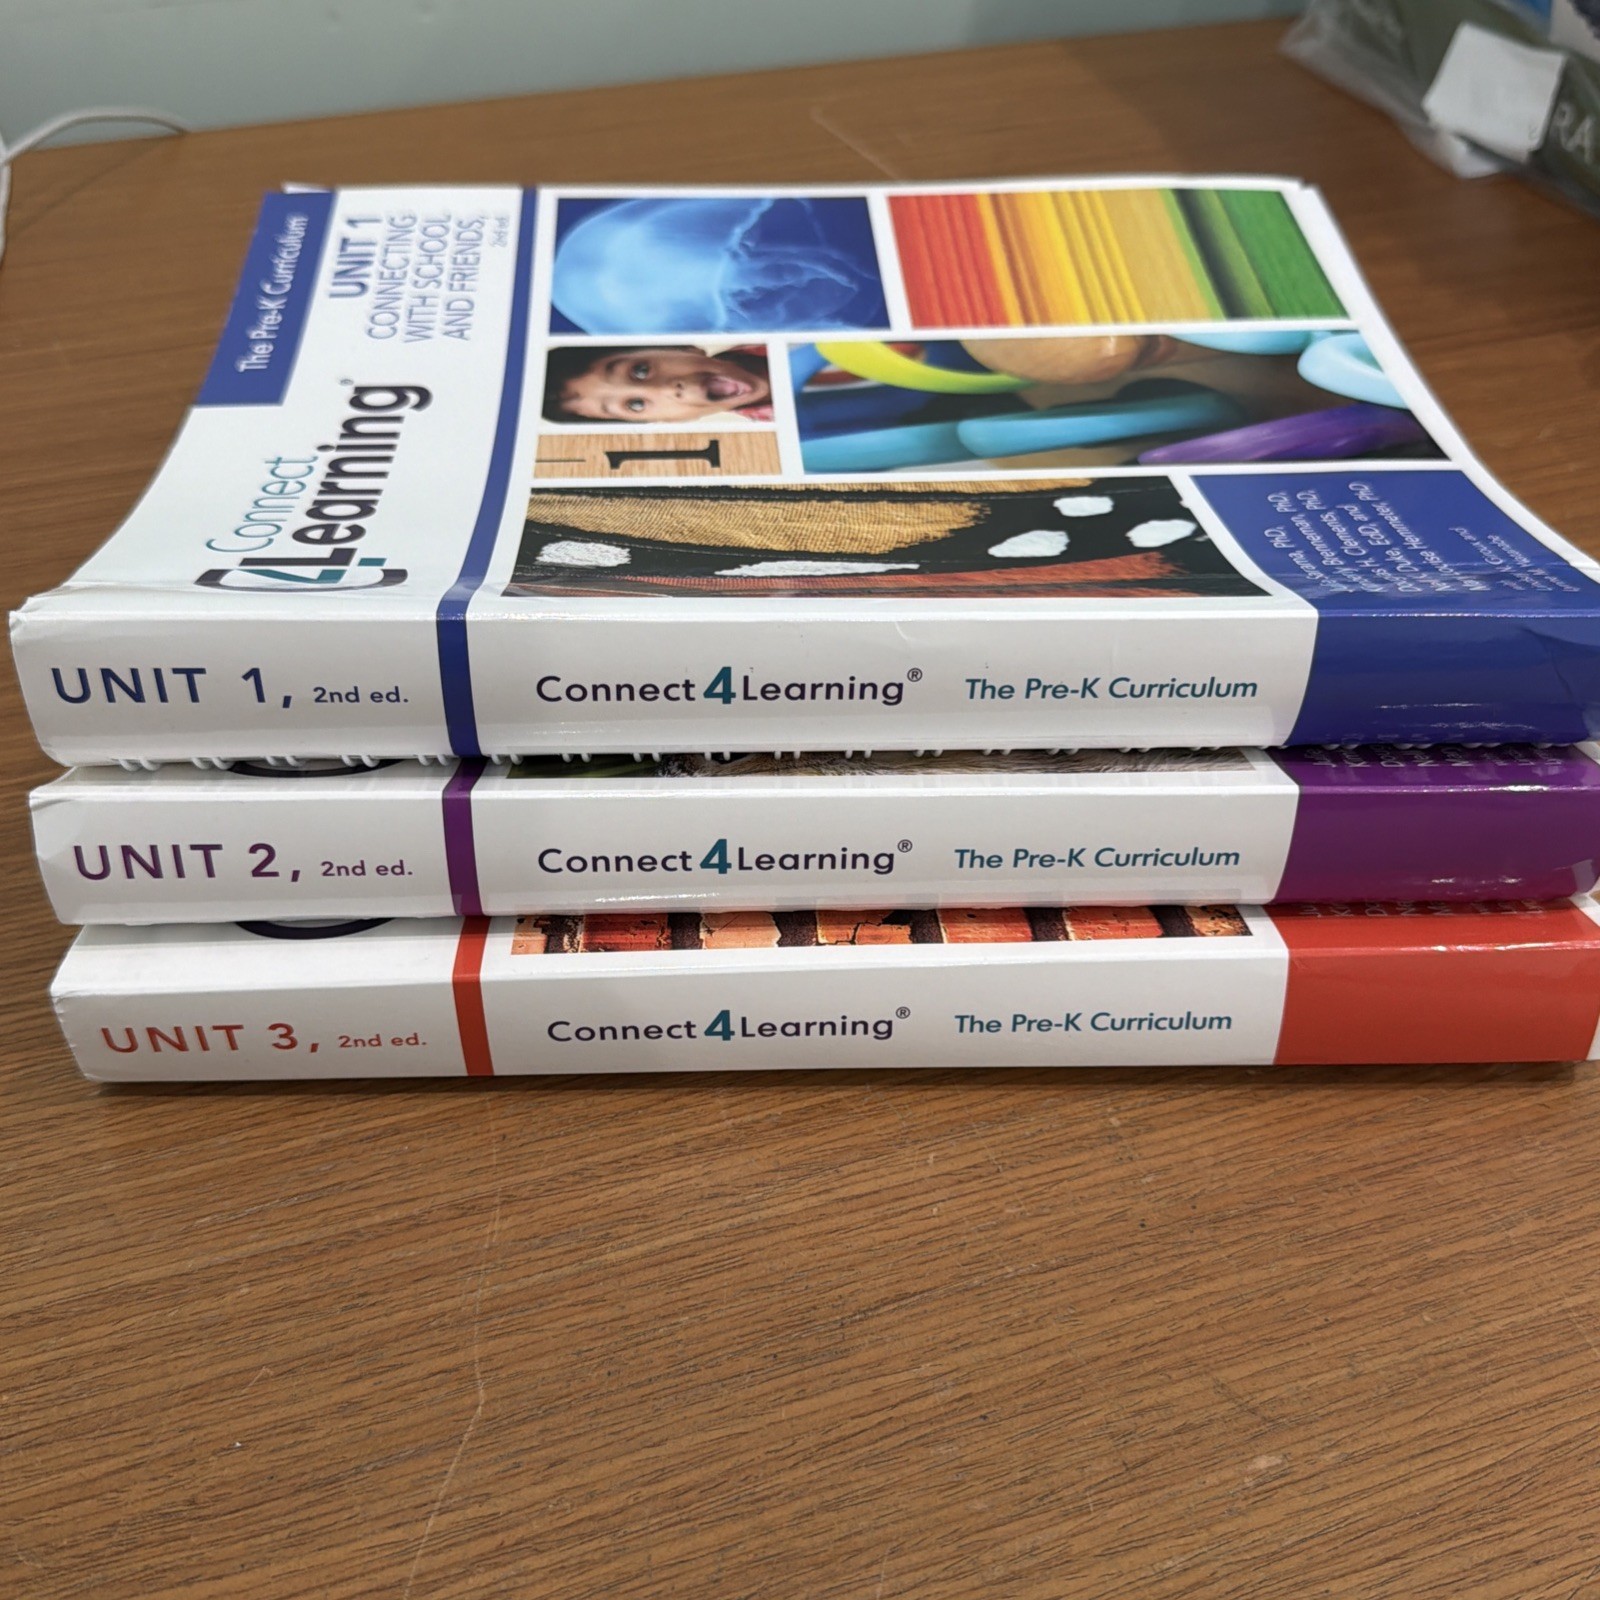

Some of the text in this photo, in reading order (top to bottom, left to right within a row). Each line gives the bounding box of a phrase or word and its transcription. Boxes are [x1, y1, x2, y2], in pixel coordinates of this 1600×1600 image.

[329, 218, 383, 299] UNIT 1
[367, 214, 417, 339] CONNECTING
[403, 214, 451, 343] WITH SCHOOL
[442, 214, 488, 341] AND FRIENDS,
[235, 214, 309, 373] The Pre-K Curriculum
[605, 439, 721, 469] 1
[206, 456, 318, 553] Connect
[1348, 483, 1379, 502] PhD
[1335, 505, 1369, 521] and
[51, 667, 409, 709] UNIT 1, 2nd ed.
[965, 676, 1258, 700] The Pre-K Curriculum
[73, 843, 414, 883] UNIT 2, 2nd ed.
[954, 846, 1241, 869] The Pre-K Curriculum
[101, 1022, 427, 1053] UNIT 3, 2nd ed.
[954, 1011, 1232, 1034] The Pre-K Curriculum
